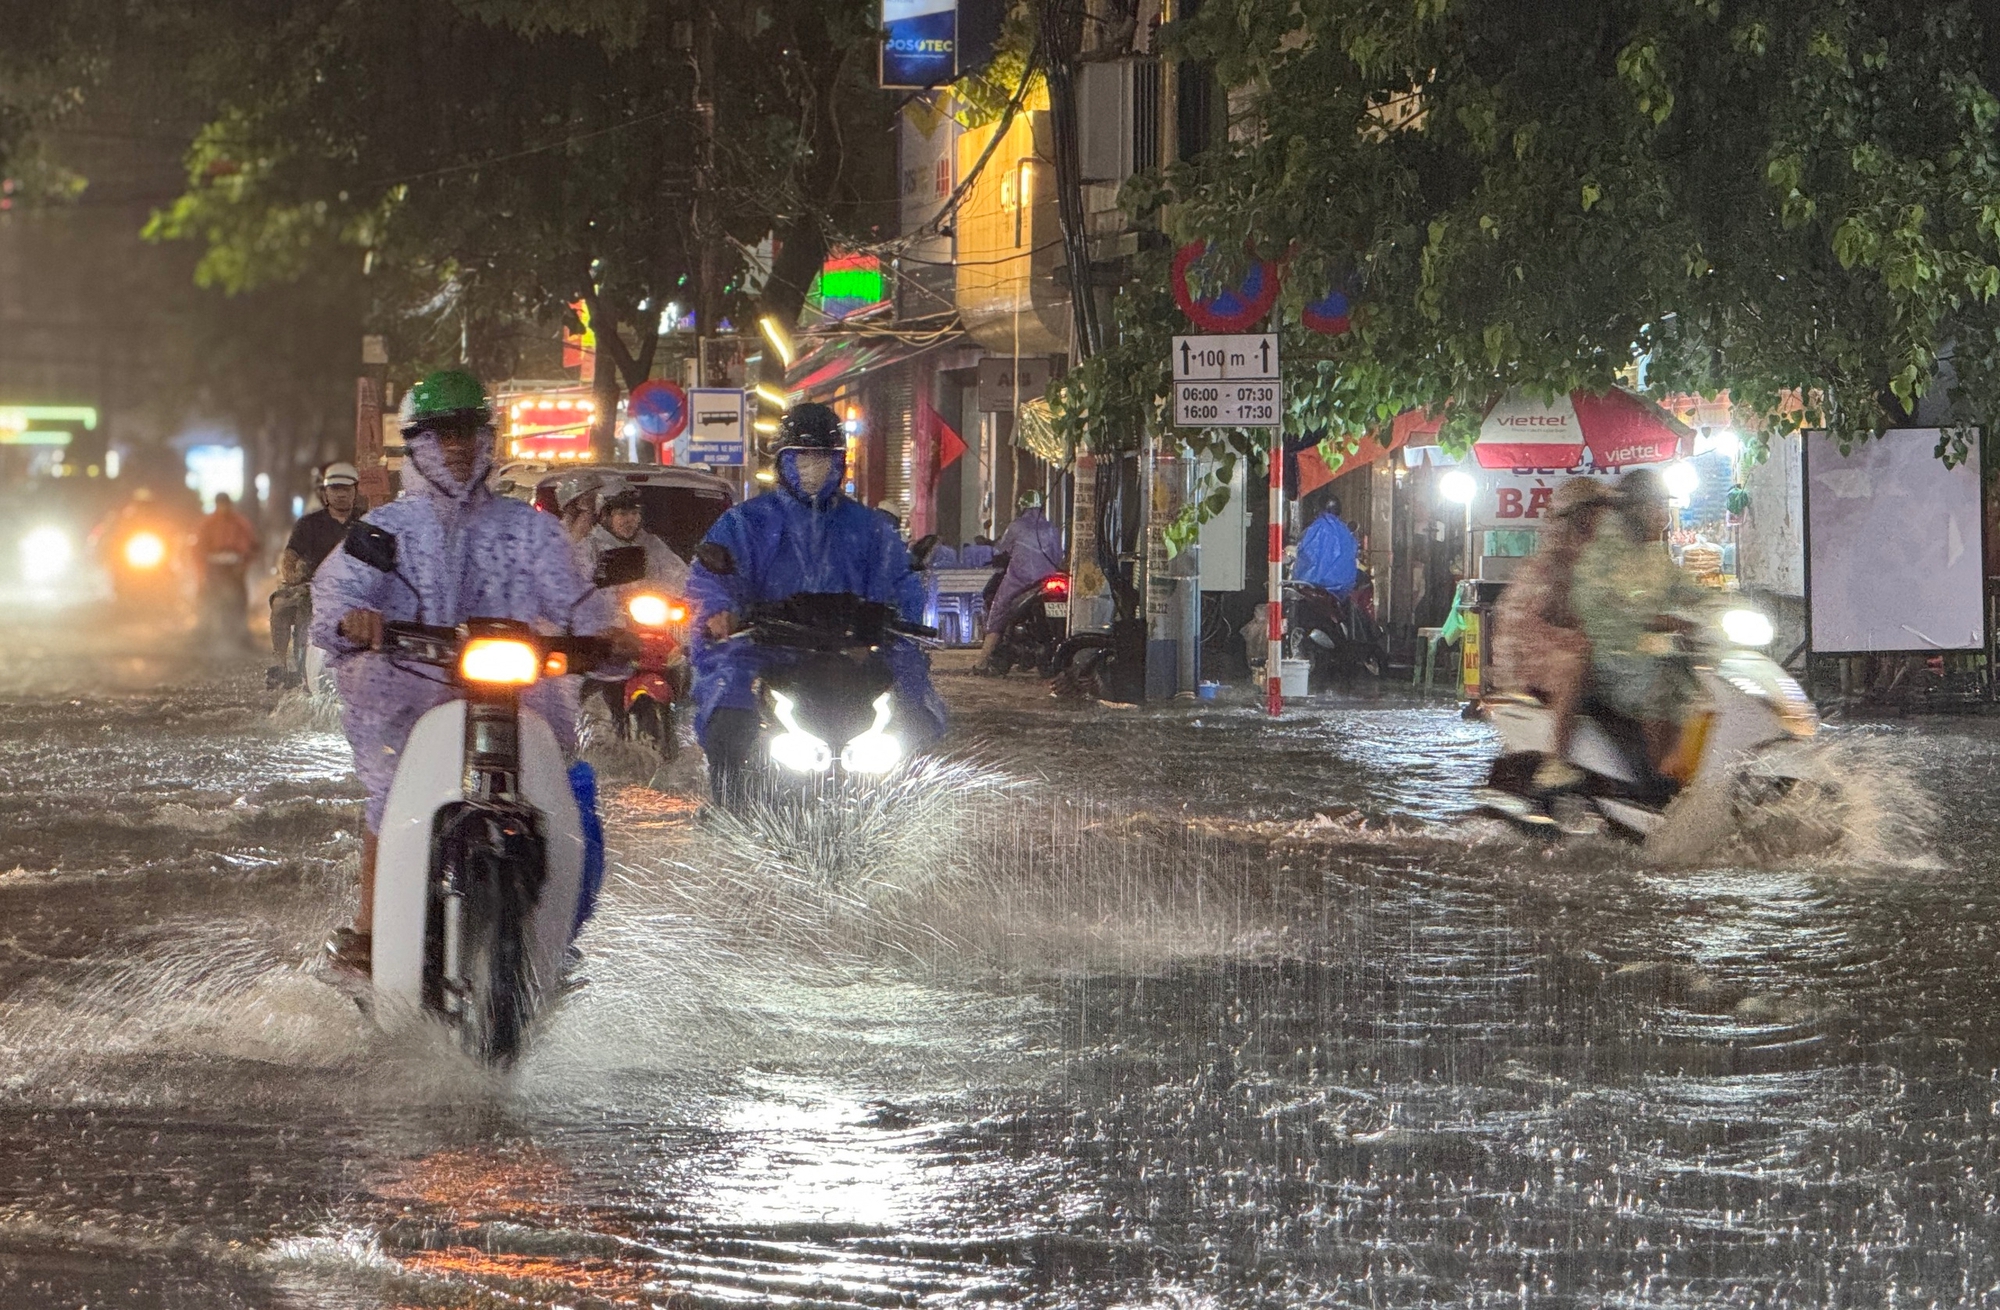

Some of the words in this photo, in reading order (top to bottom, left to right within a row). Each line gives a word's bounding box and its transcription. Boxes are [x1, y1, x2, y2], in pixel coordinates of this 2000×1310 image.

[1198, 350, 1225, 367] 100
[1230, 353, 1245, 366] m
[1182, 387, 1218, 401] 06:00
[1237, 388, 1273, 401] 07:30
[1183, 405, 1218, 419] 16:00
[1237, 405, 1273, 419] 17:30
[1497, 415, 1567, 426] viettel
[1604, 443, 1663, 463] viettel
